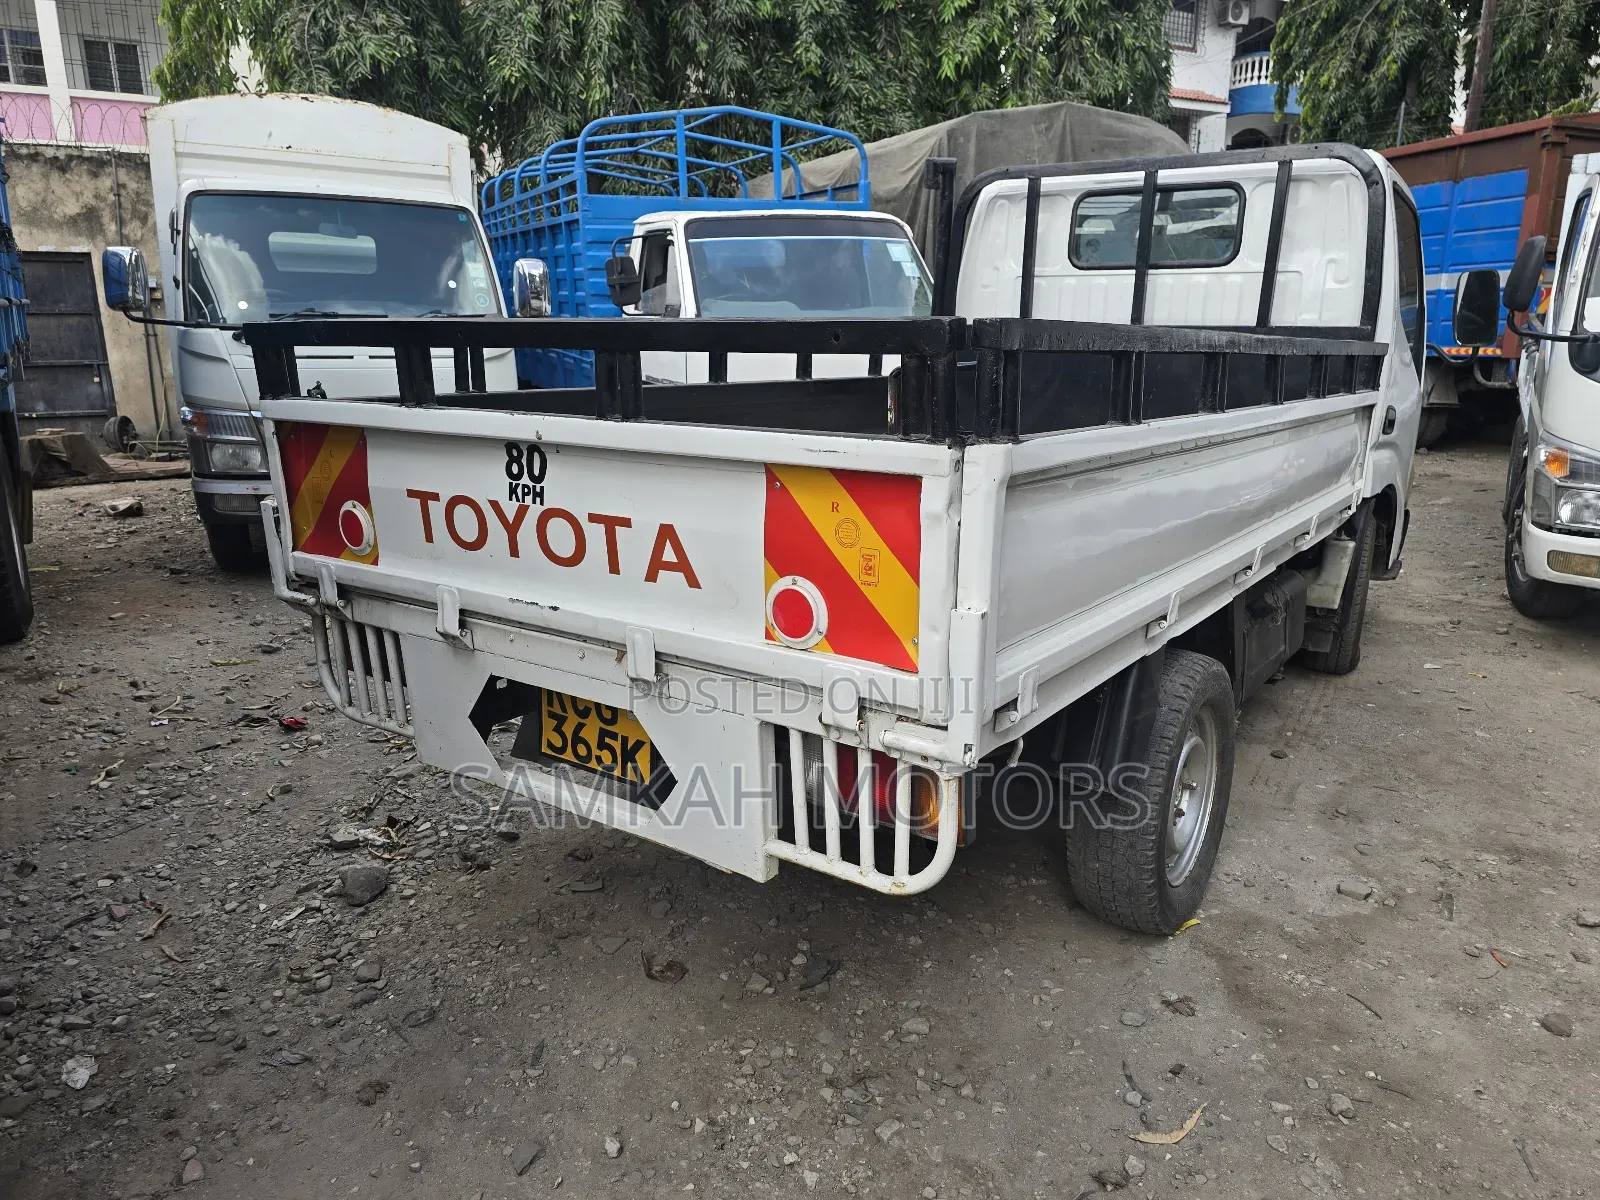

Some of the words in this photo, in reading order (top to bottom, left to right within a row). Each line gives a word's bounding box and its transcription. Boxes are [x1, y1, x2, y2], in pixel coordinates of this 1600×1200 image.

[504, 441, 548, 485] 80
[508, 481, 545, 506] KPH
[830, 501, 840, 513] R
[405, 487, 703, 590] TOYOTA
[546, 709, 648, 785] 365K
